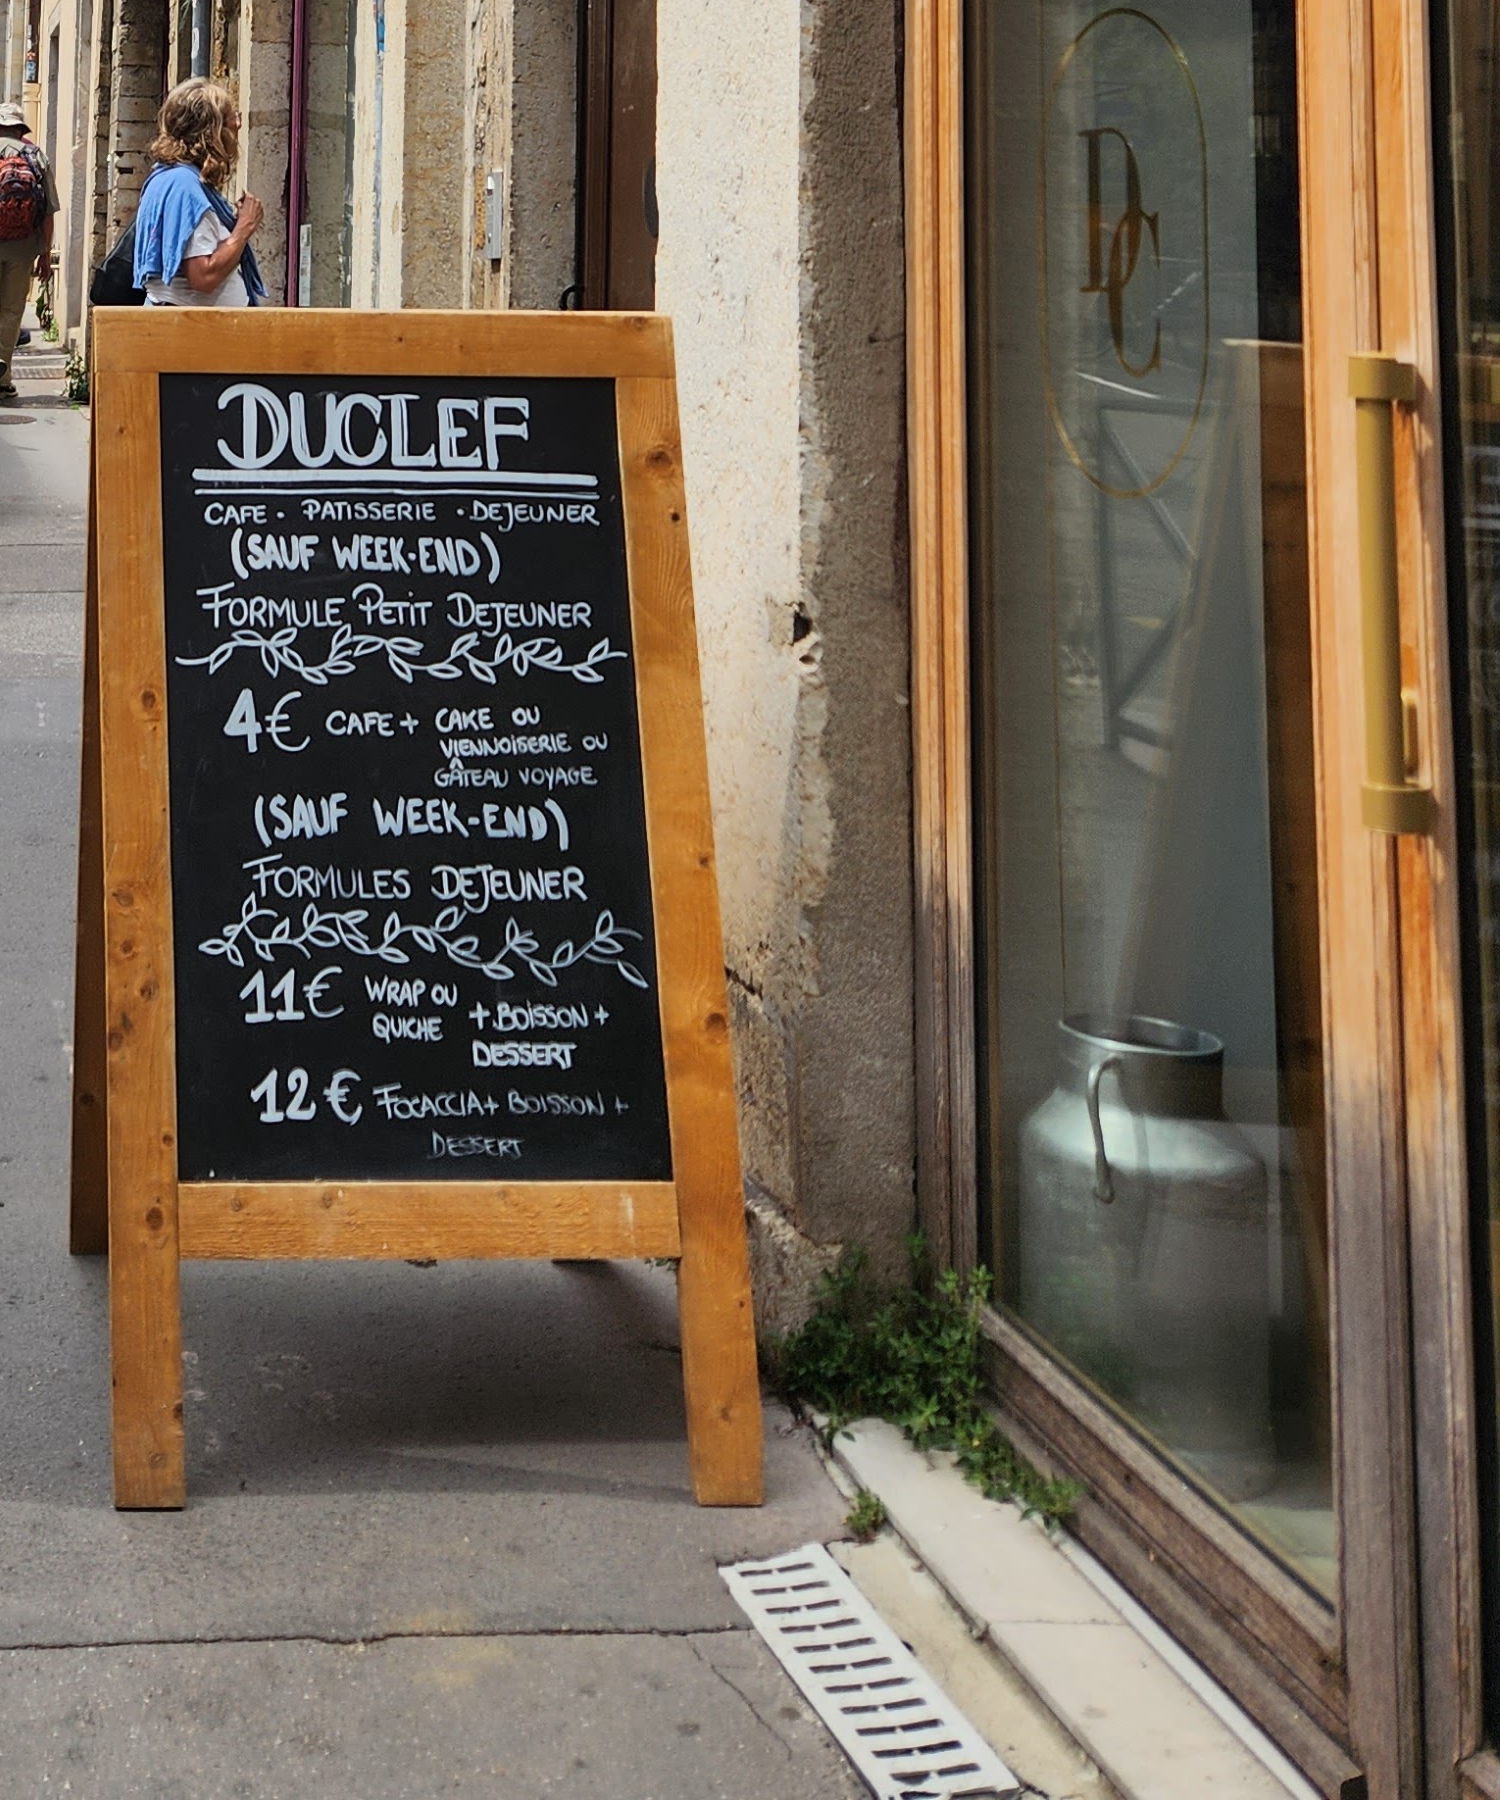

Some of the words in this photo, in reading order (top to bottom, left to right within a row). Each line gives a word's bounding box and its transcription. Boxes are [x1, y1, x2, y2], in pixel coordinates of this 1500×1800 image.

[217, 383, 530, 470] DUCLEF
[204, 502, 267, 526] CAFE
[301, 498, 436, 522] PATISSERIE
[196, 582, 347, 628] FORMULE
[352, 583, 433, 627] PETIT
[447, 591, 592, 639] DEJEUNER
[435, 707, 494, 733] CAKE
[511, 705, 541, 727] OU
[582, 732, 608, 751] OU
[433, 756, 510, 788] GÂTEAU
[518, 765, 598, 791] VOYAGE
[242, 853, 412, 899] FORMULES
[431, 863, 588, 914] DEJEUNER
[364, 975, 426, 1007] WRAP
[431, 983, 458, 1007] OU
[372, 1012, 444, 1044] QUICHE
[472, 1039, 578, 1070] DESSERT
